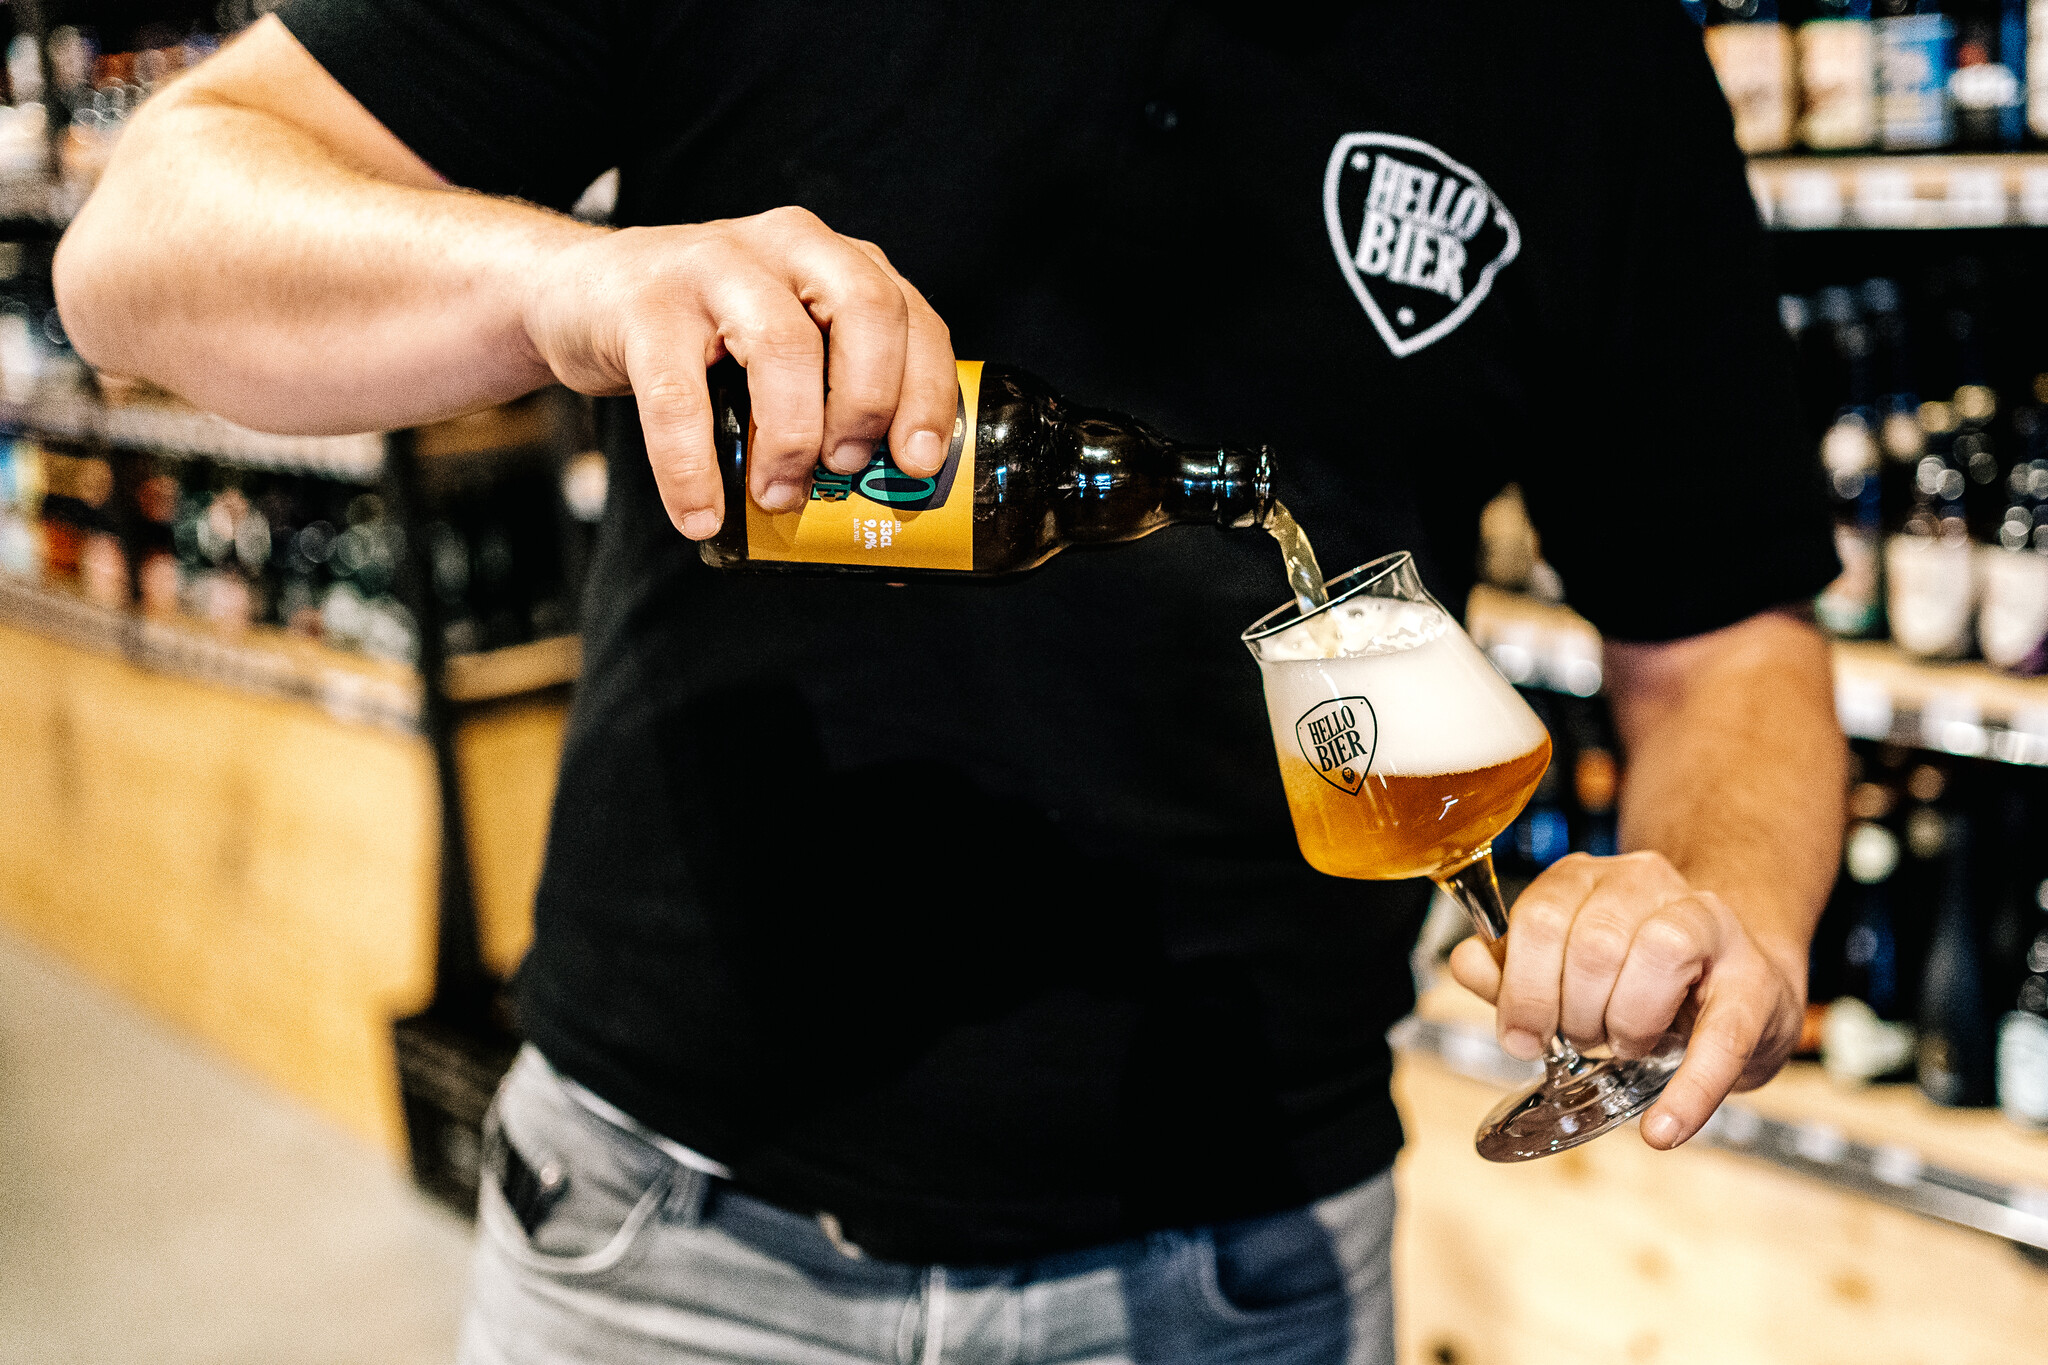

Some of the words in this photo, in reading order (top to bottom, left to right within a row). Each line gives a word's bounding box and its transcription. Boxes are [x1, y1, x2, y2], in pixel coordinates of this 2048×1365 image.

[1365, 153, 1490, 241] HELLO
[1355, 212, 1468, 302] BIER
[862, 519, 877, 549] 9,0%
[1307, 705, 1355, 745] HELLO
[1315, 730, 1367, 772] BIER
